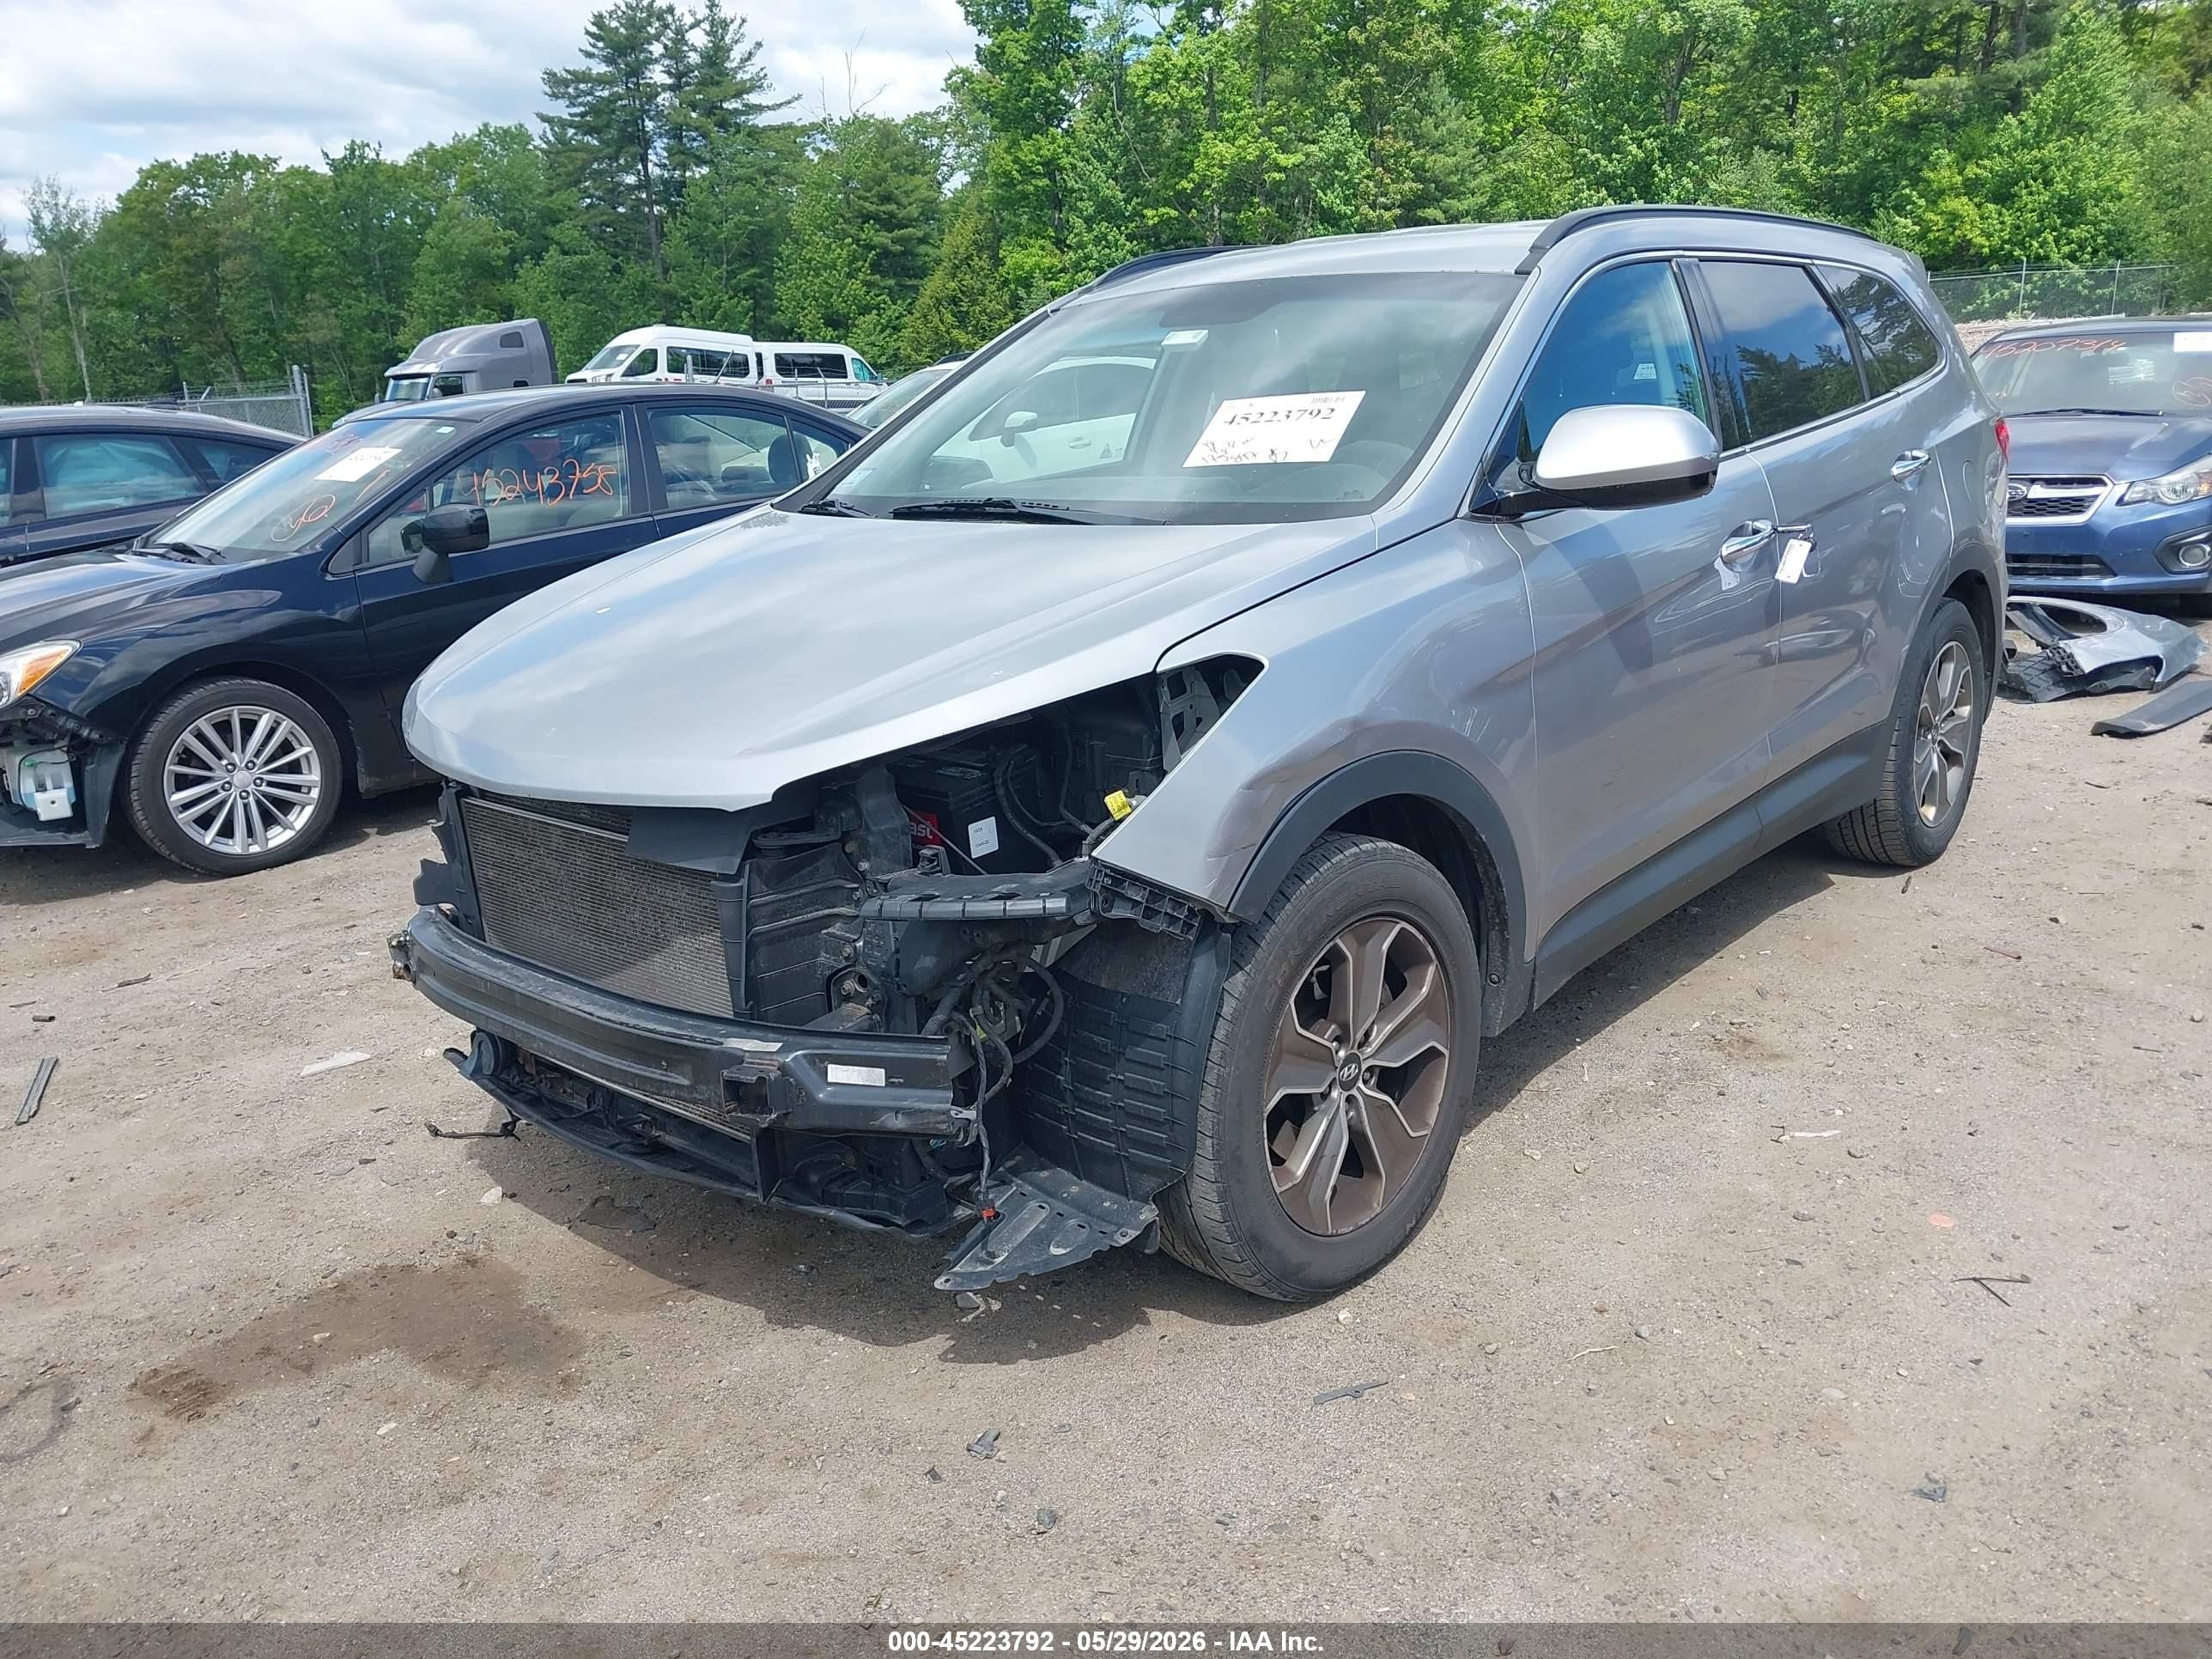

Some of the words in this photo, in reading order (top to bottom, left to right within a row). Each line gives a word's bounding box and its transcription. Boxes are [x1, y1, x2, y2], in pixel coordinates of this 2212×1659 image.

[1224, 407, 1336, 425] 45223792
[457, 458, 618, 507] 45243758
[910, 820, 934, 840] ast
